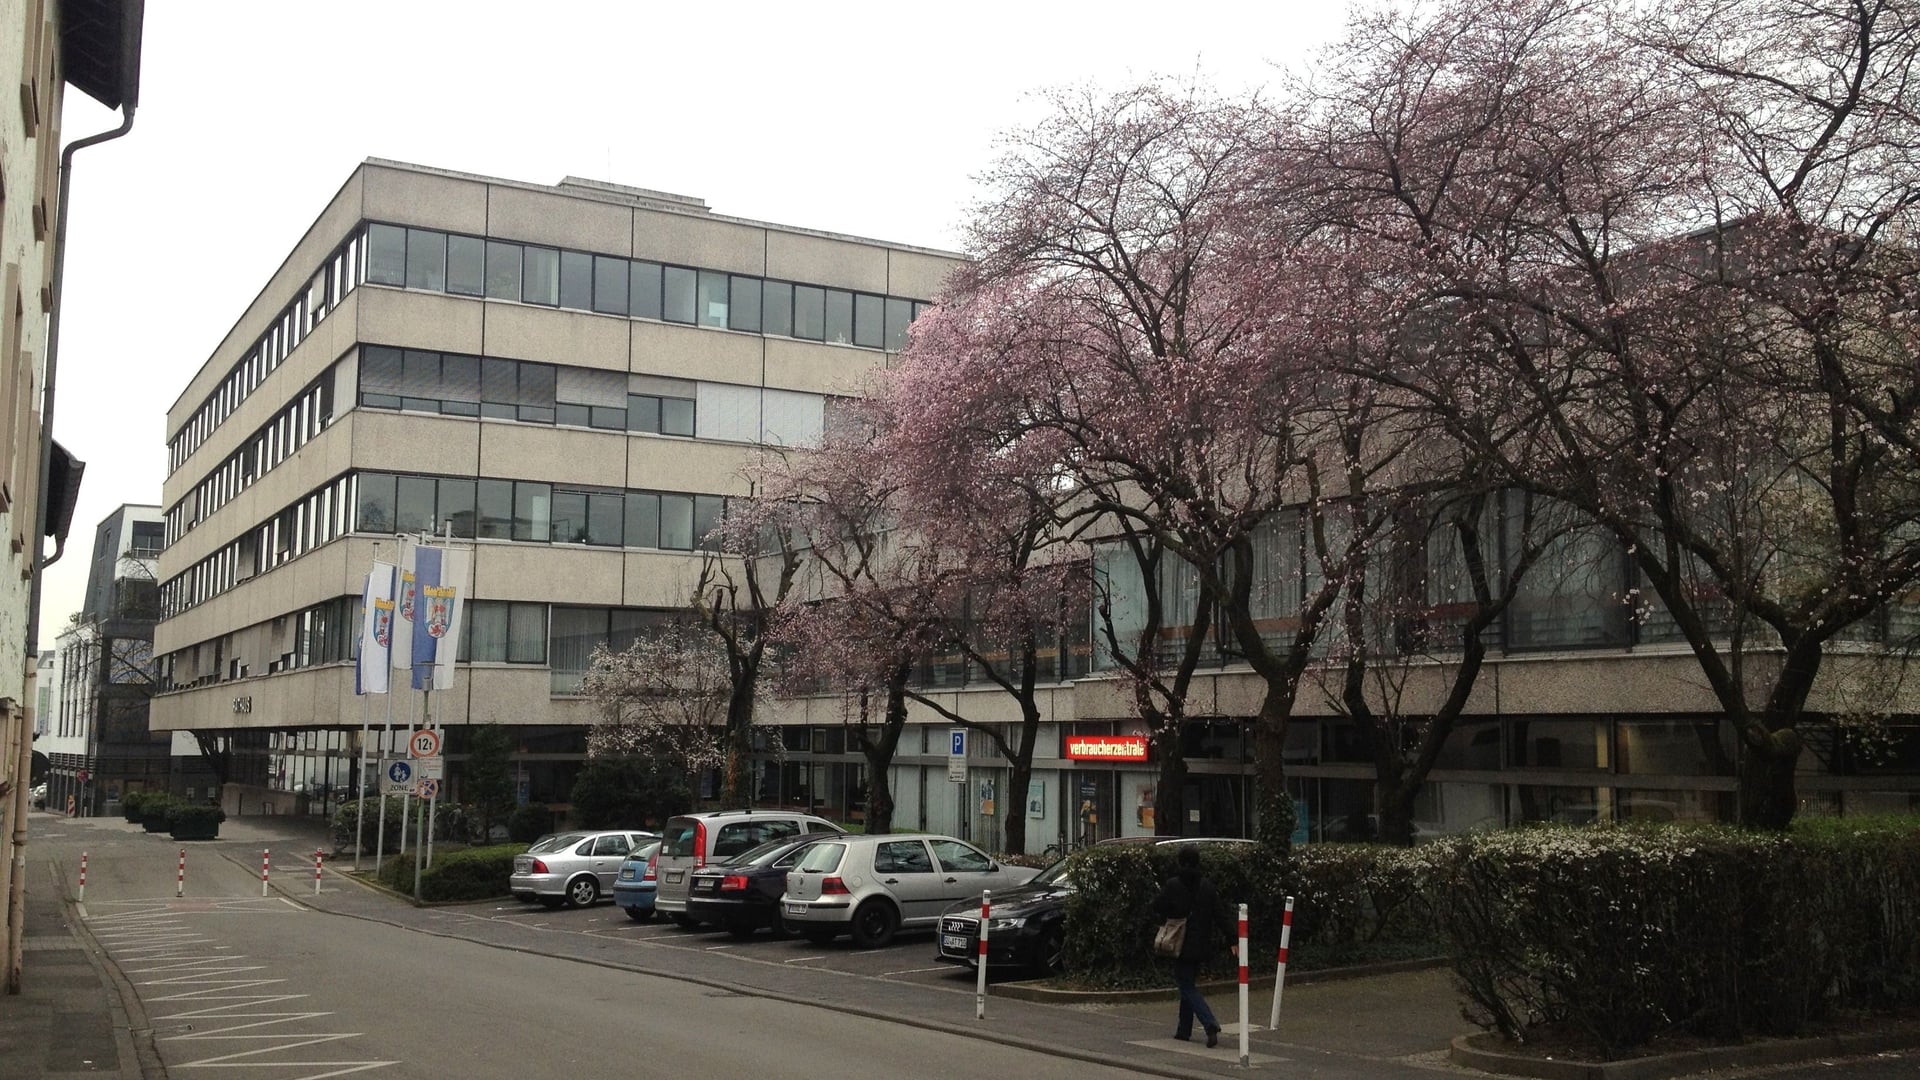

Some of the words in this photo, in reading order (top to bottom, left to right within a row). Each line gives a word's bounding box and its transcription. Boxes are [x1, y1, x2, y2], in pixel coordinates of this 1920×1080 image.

[417, 738, 432, 750] 12t
[954, 735, 962, 752] P
[1070, 739, 1145, 756] verbraucherzentrale
